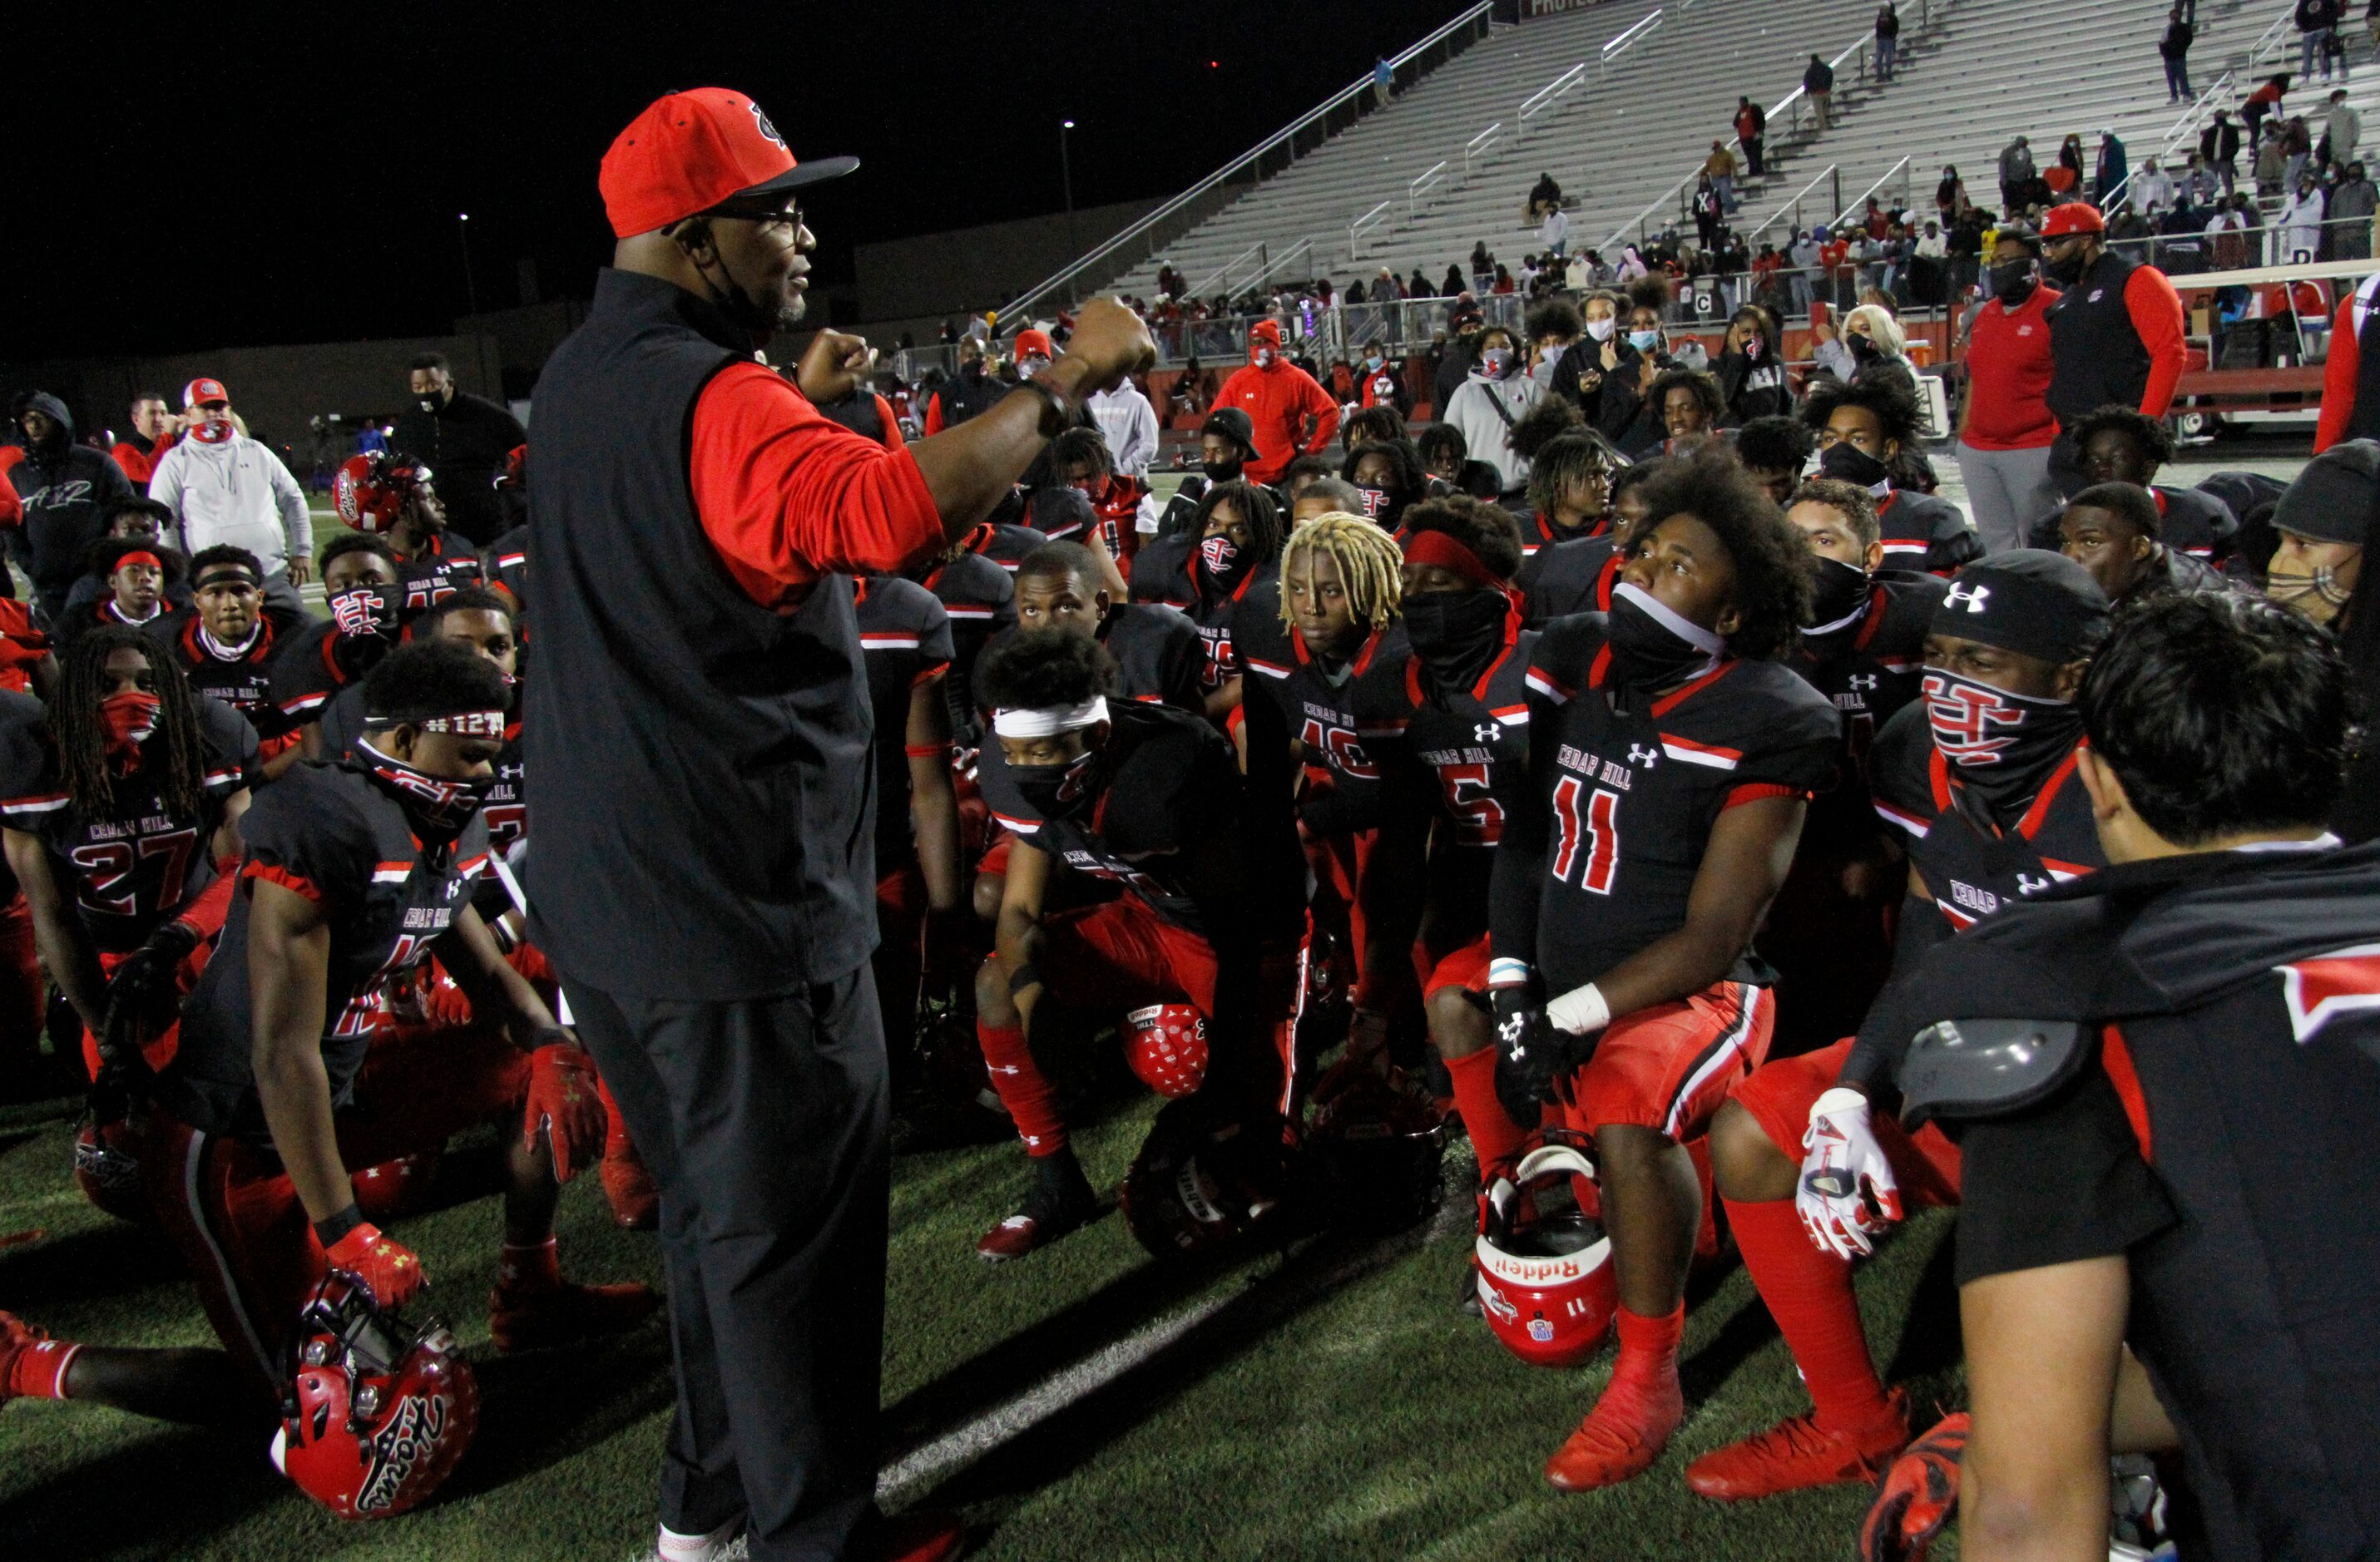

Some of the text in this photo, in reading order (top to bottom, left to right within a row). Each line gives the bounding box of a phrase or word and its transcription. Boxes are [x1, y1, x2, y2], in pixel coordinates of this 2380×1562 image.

[1698, 296, 1709, 311] C
[1462, 747, 1495, 764] HILL
[1556, 743, 1631, 791] CEDAR HILL
[1436, 763, 1506, 847] 5
[1552, 774, 1619, 896] 11
[71, 827, 198, 916] 27
[1949, 878, 1997, 915] CEDAR
[403, 907, 434, 928] CEDAR
[1495, 1258, 1580, 1281] Riddell
[1566, 1297, 1586, 1317] 11
